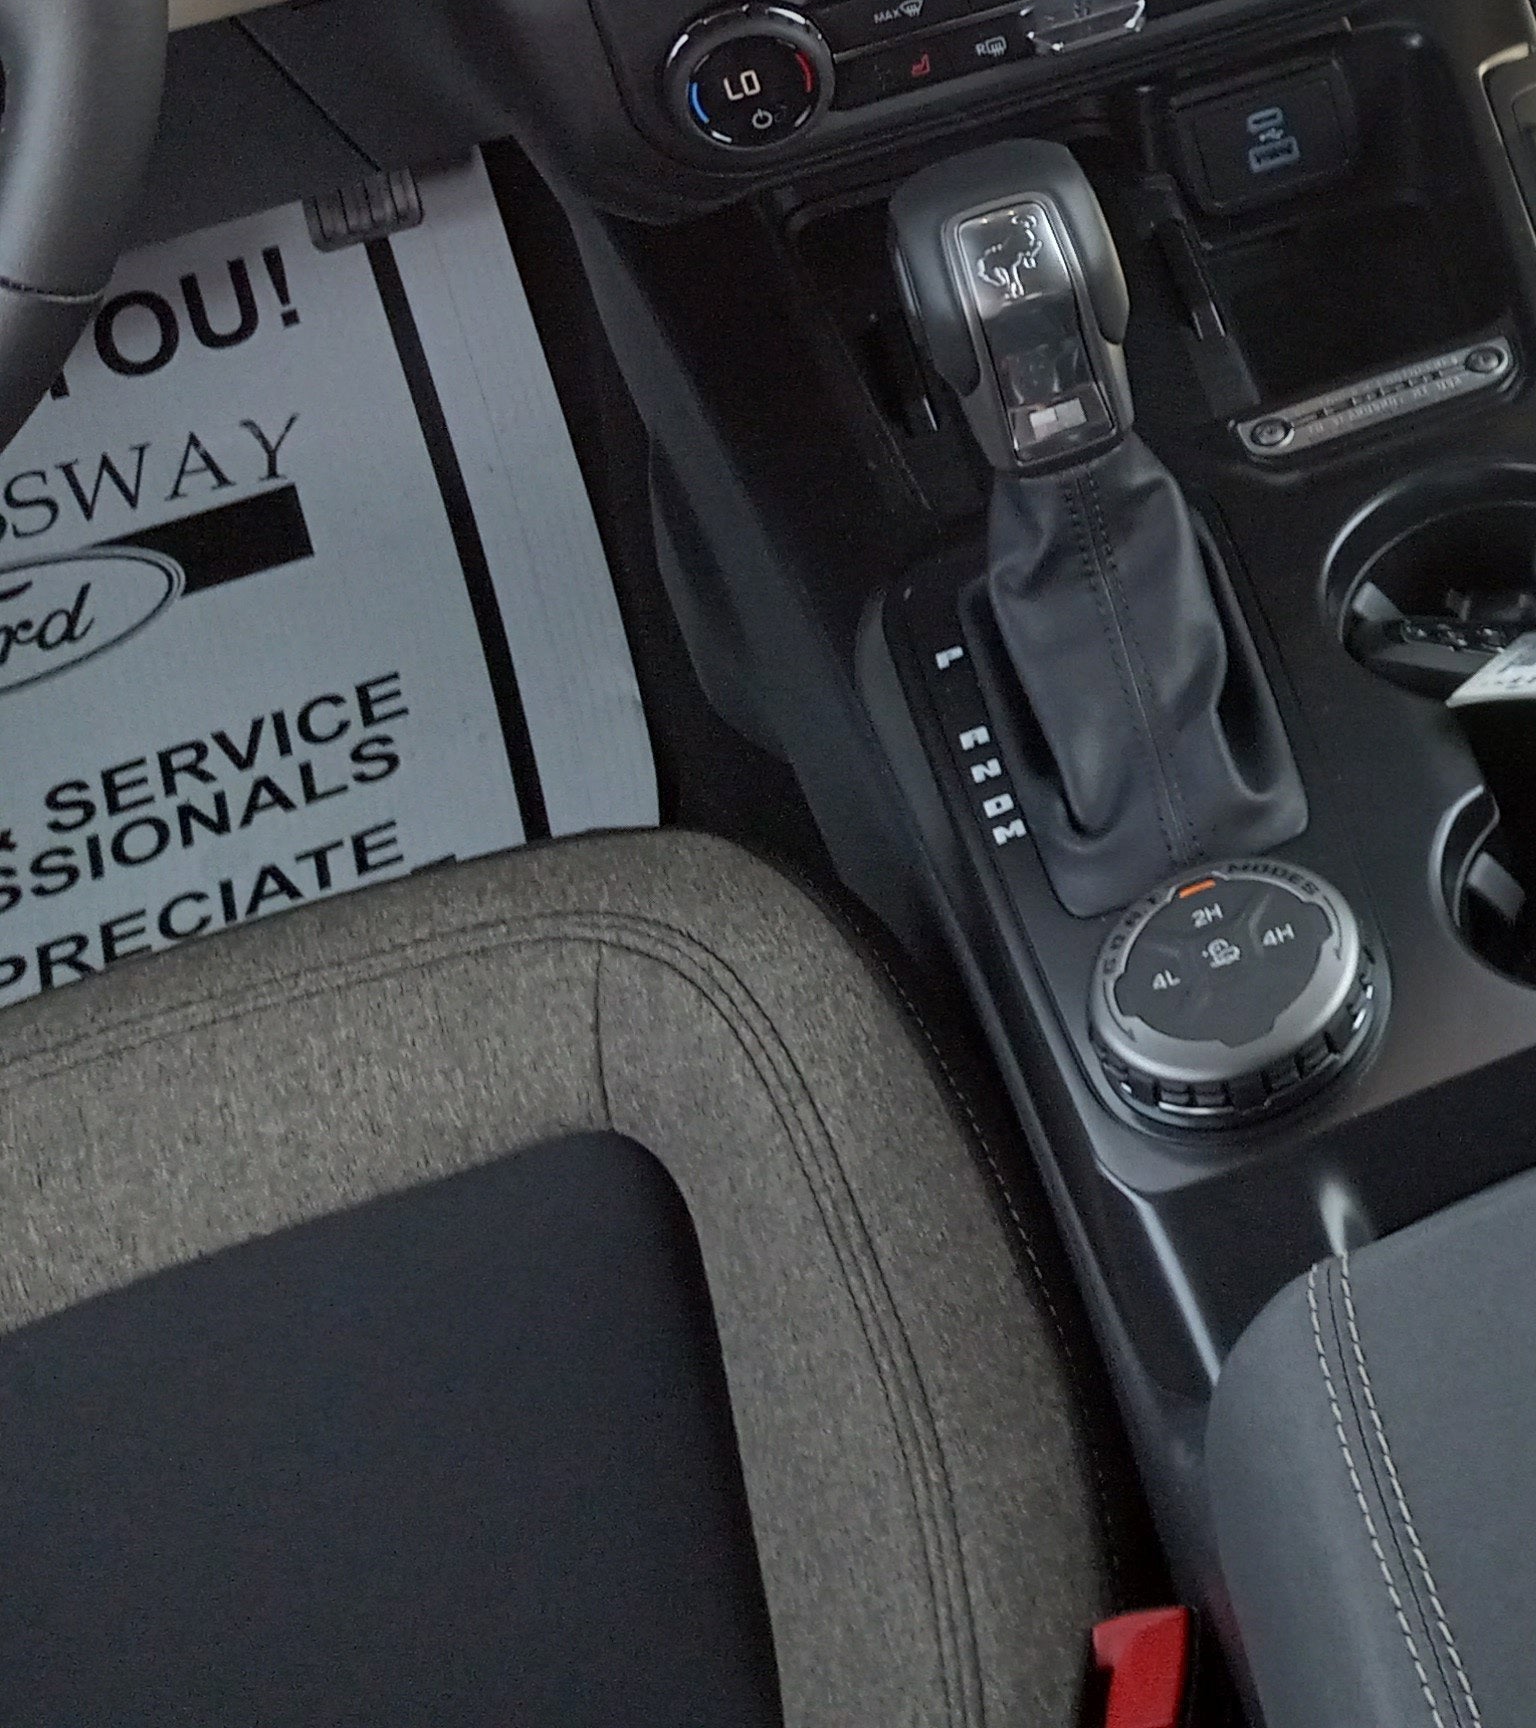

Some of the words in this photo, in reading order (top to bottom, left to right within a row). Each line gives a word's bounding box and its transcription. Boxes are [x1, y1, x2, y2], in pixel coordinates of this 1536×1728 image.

[873, 7, 901, 24] MAX
[722, 69, 762, 102] LO
[48, 246, 301, 400] OU!
[43, 672, 410, 834] SERVICE
[970, 757, 1002, 784] N
[983, 793, 1014, 818] D
[992, 818, 1027, 846] M
[1190, 902, 1225, 929] 2H
[1262, 922, 1296, 947] 4H
[1152, 969, 1182, 991] 4L
